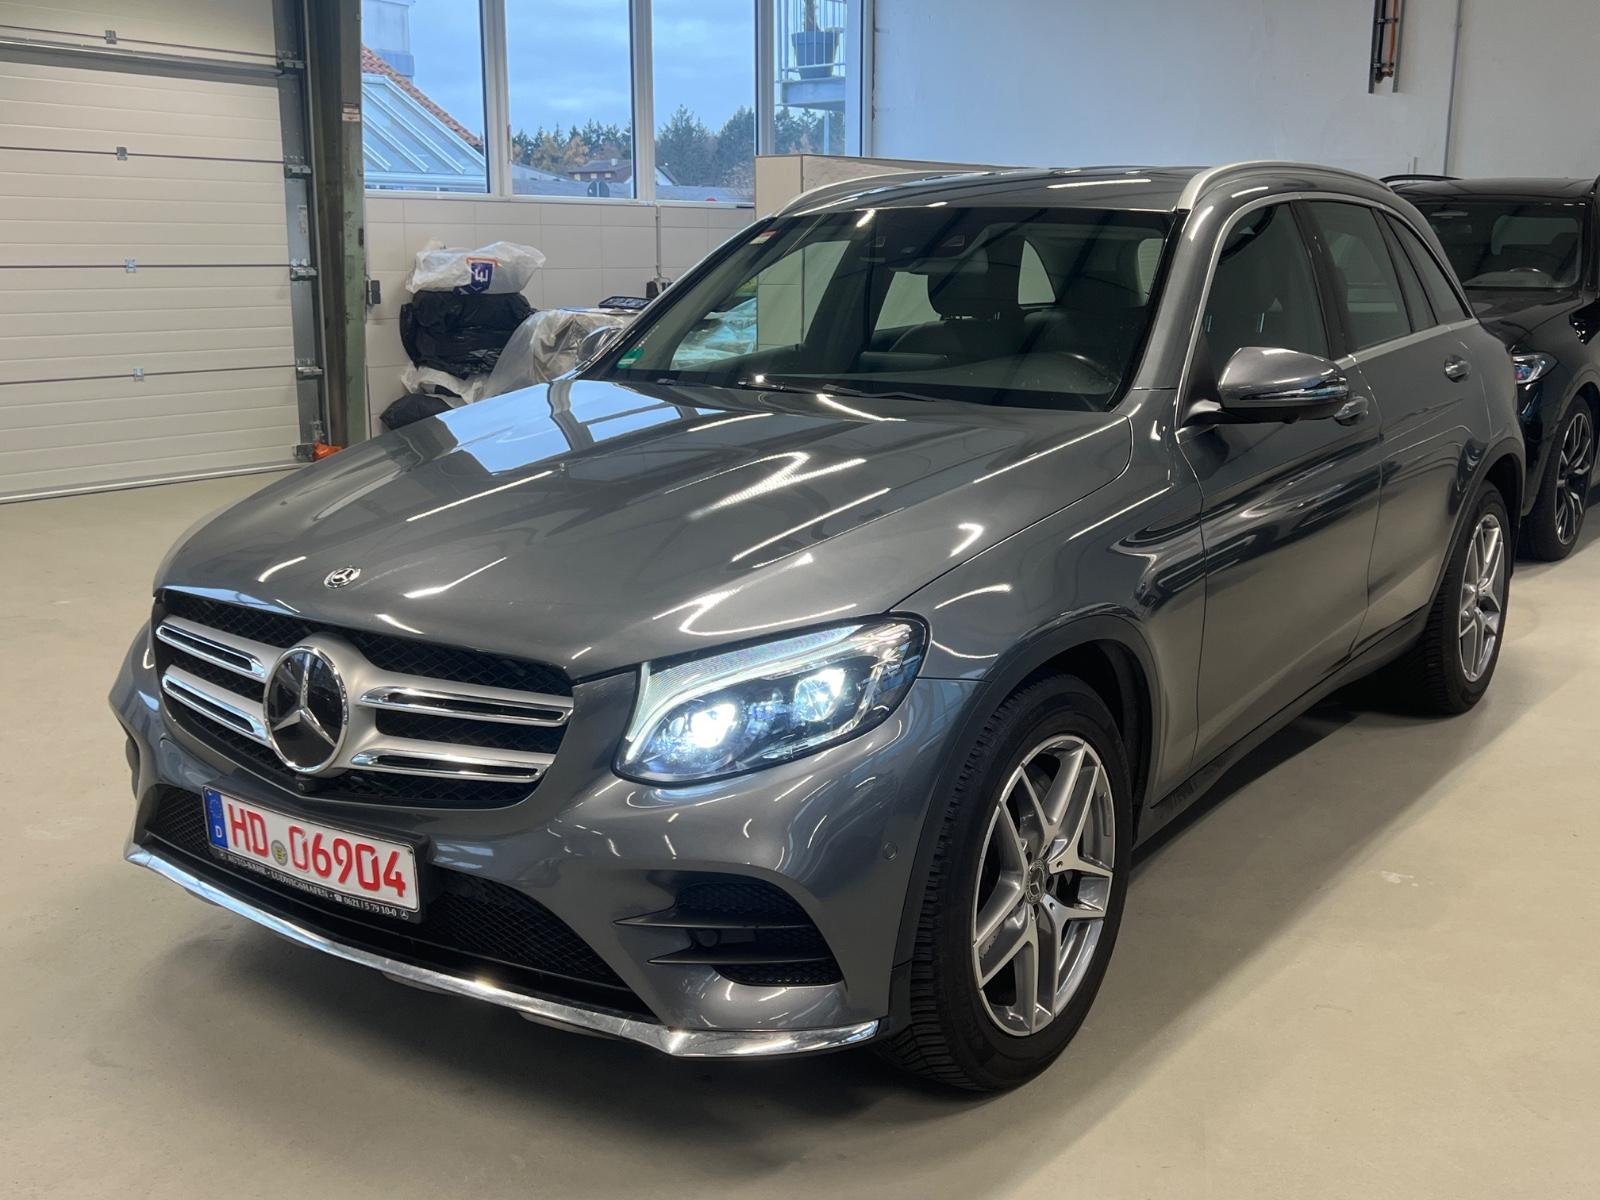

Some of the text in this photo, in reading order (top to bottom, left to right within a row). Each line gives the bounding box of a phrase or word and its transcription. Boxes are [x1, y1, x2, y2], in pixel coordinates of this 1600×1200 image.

[215, 825, 223, 838] D
[228, 803, 406, 897] HD 06904
[271, 871, 329, 898] LUDWIGSHAFEN
[344, 897, 360, 909] 0621
[370, 903, 380, 913] 79
